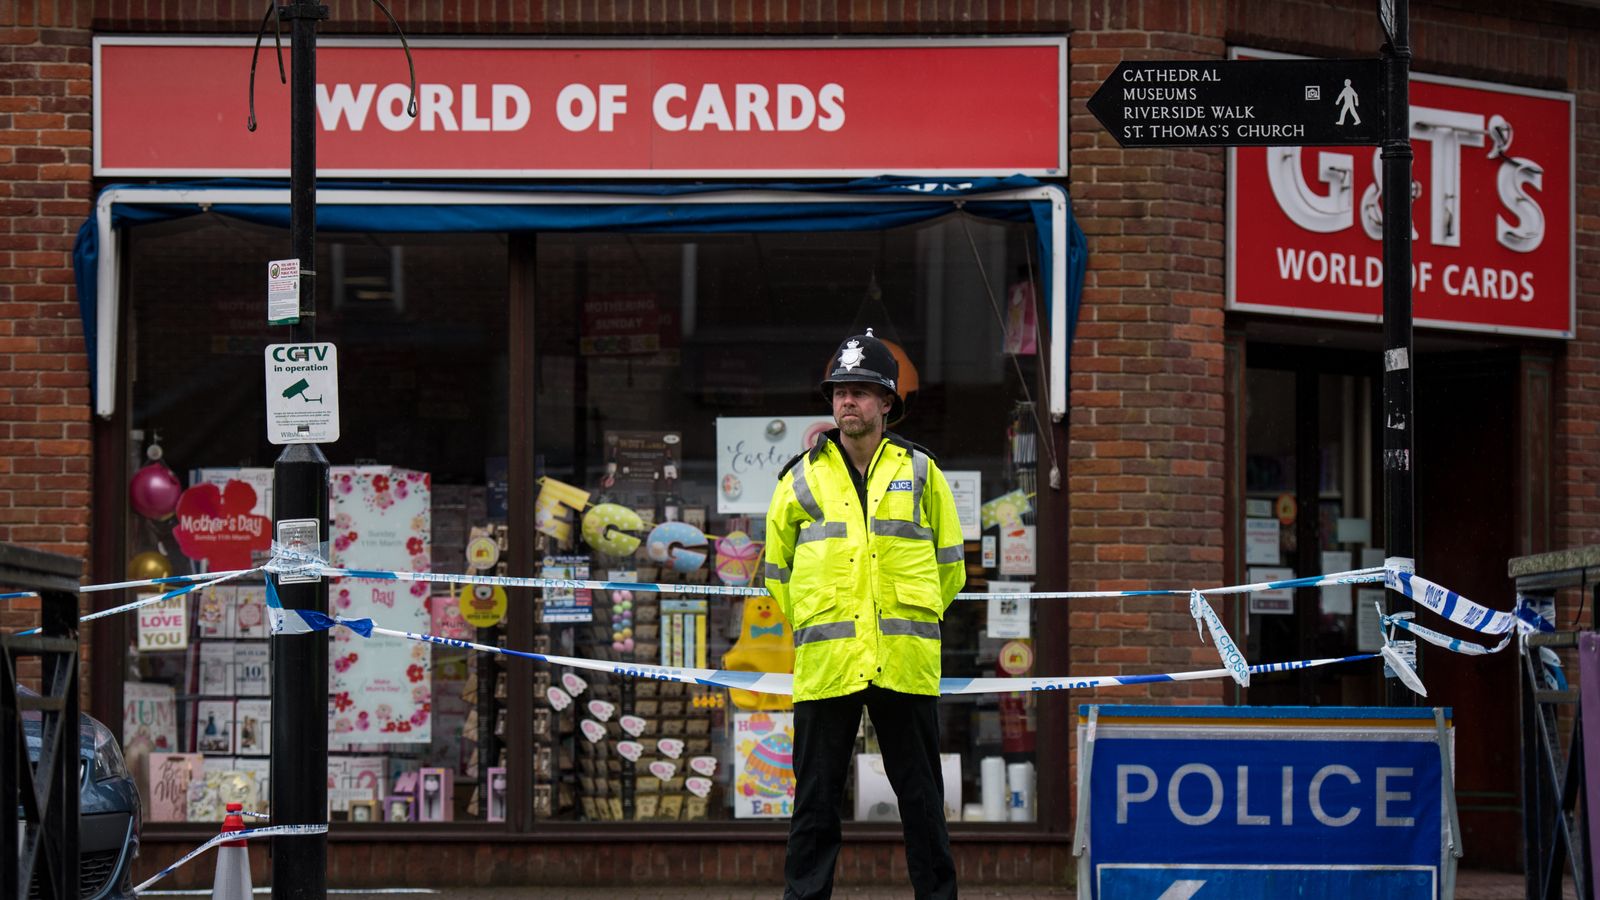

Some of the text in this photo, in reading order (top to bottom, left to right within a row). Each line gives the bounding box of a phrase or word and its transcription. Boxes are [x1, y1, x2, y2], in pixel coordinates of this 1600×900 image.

[1122, 69, 1221, 82] CATHEDRAL
[1123, 88, 1197, 101] MUSEUMS
[315, 83, 846, 132] WORLD OF CARDS
[1123, 106, 1255, 119] RIVERSIDE WALK
[1123, 124, 1305, 138] ST. THOMAS'S CHURCH
[1276, 247, 1535, 302] WORLD F CARDS
[272, 346, 329, 362] CCTV
[285, 364, 328, 373] operation
[888, 480, 912, 491] OLICE
[181, 514, 236, 534] Mother's
[238, 515, 263, 537] Day
[371, 588, 395, 608] Day
[141, 615, 182, 628] LOVE
[143, 633, 180, 645] YOU
[1219, 635, 1249, 680] CROSS
[1116, 763, 1415, 827] POLICE
